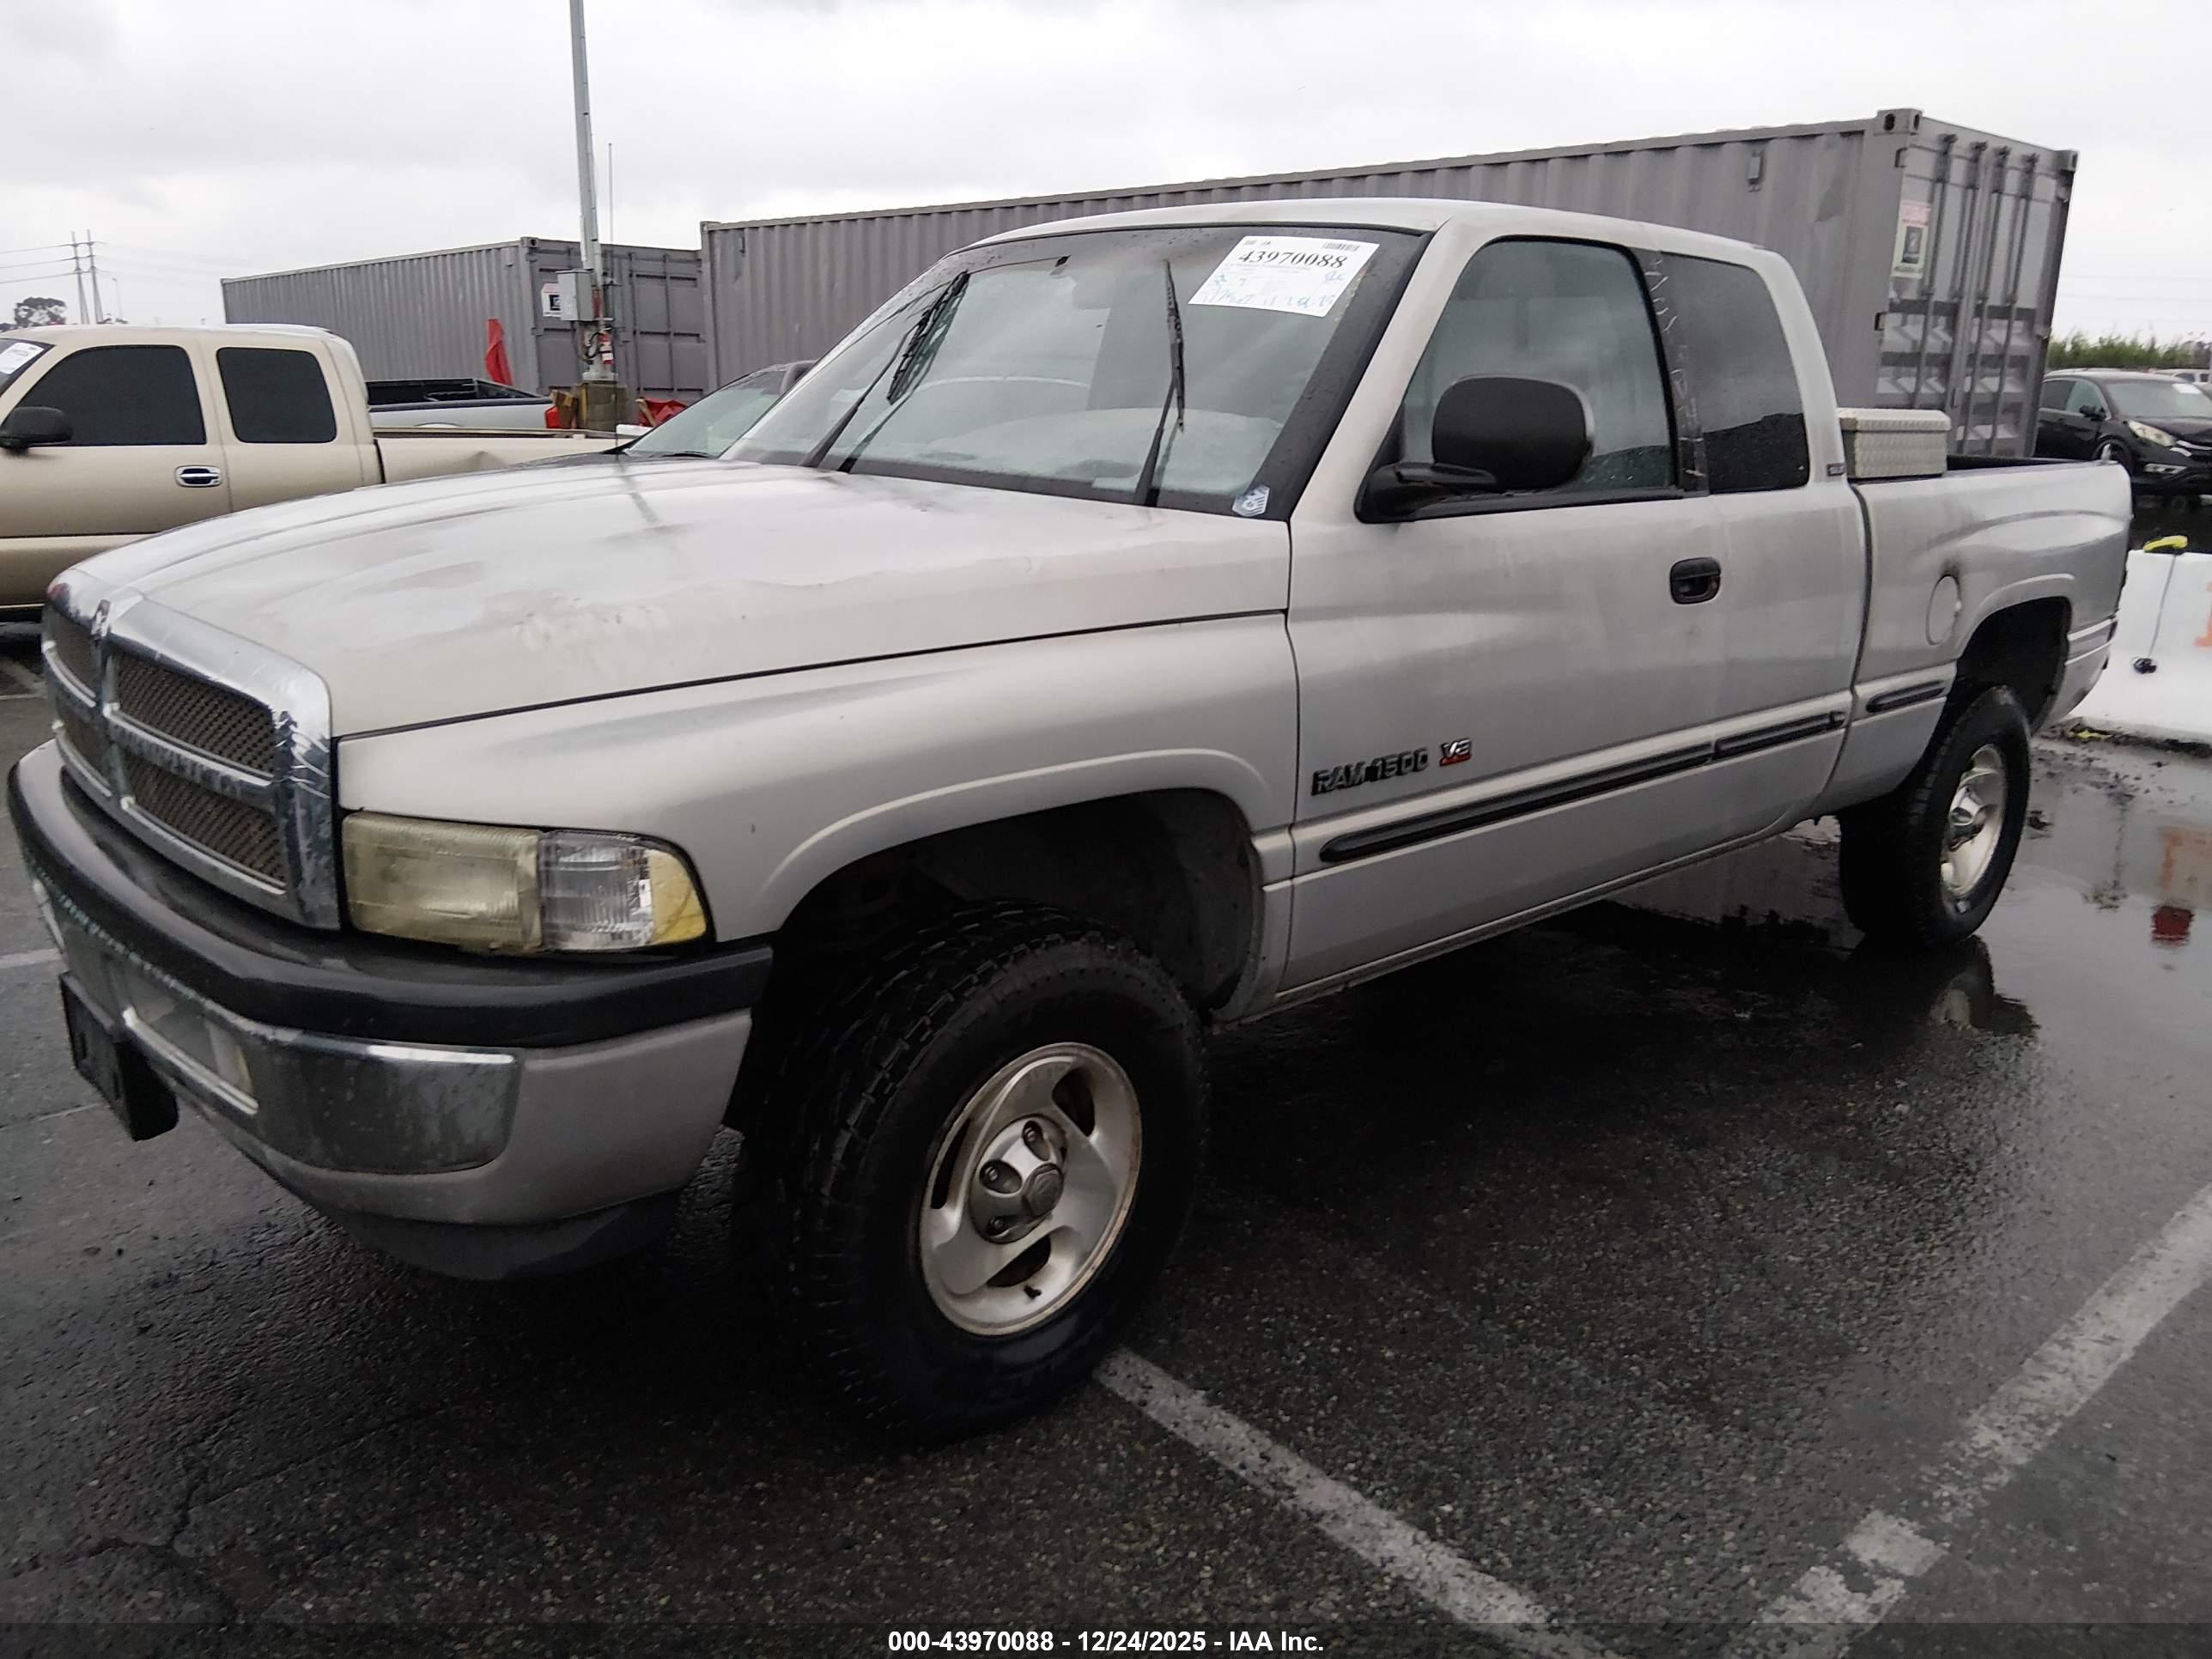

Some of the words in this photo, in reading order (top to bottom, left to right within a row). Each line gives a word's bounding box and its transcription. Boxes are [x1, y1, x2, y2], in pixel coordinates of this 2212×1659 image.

[1237, 249, 1348, 269] 43970088
[1312, 761, 1367, 795] RAM
[1370, 747, 1429, 781] 1500
